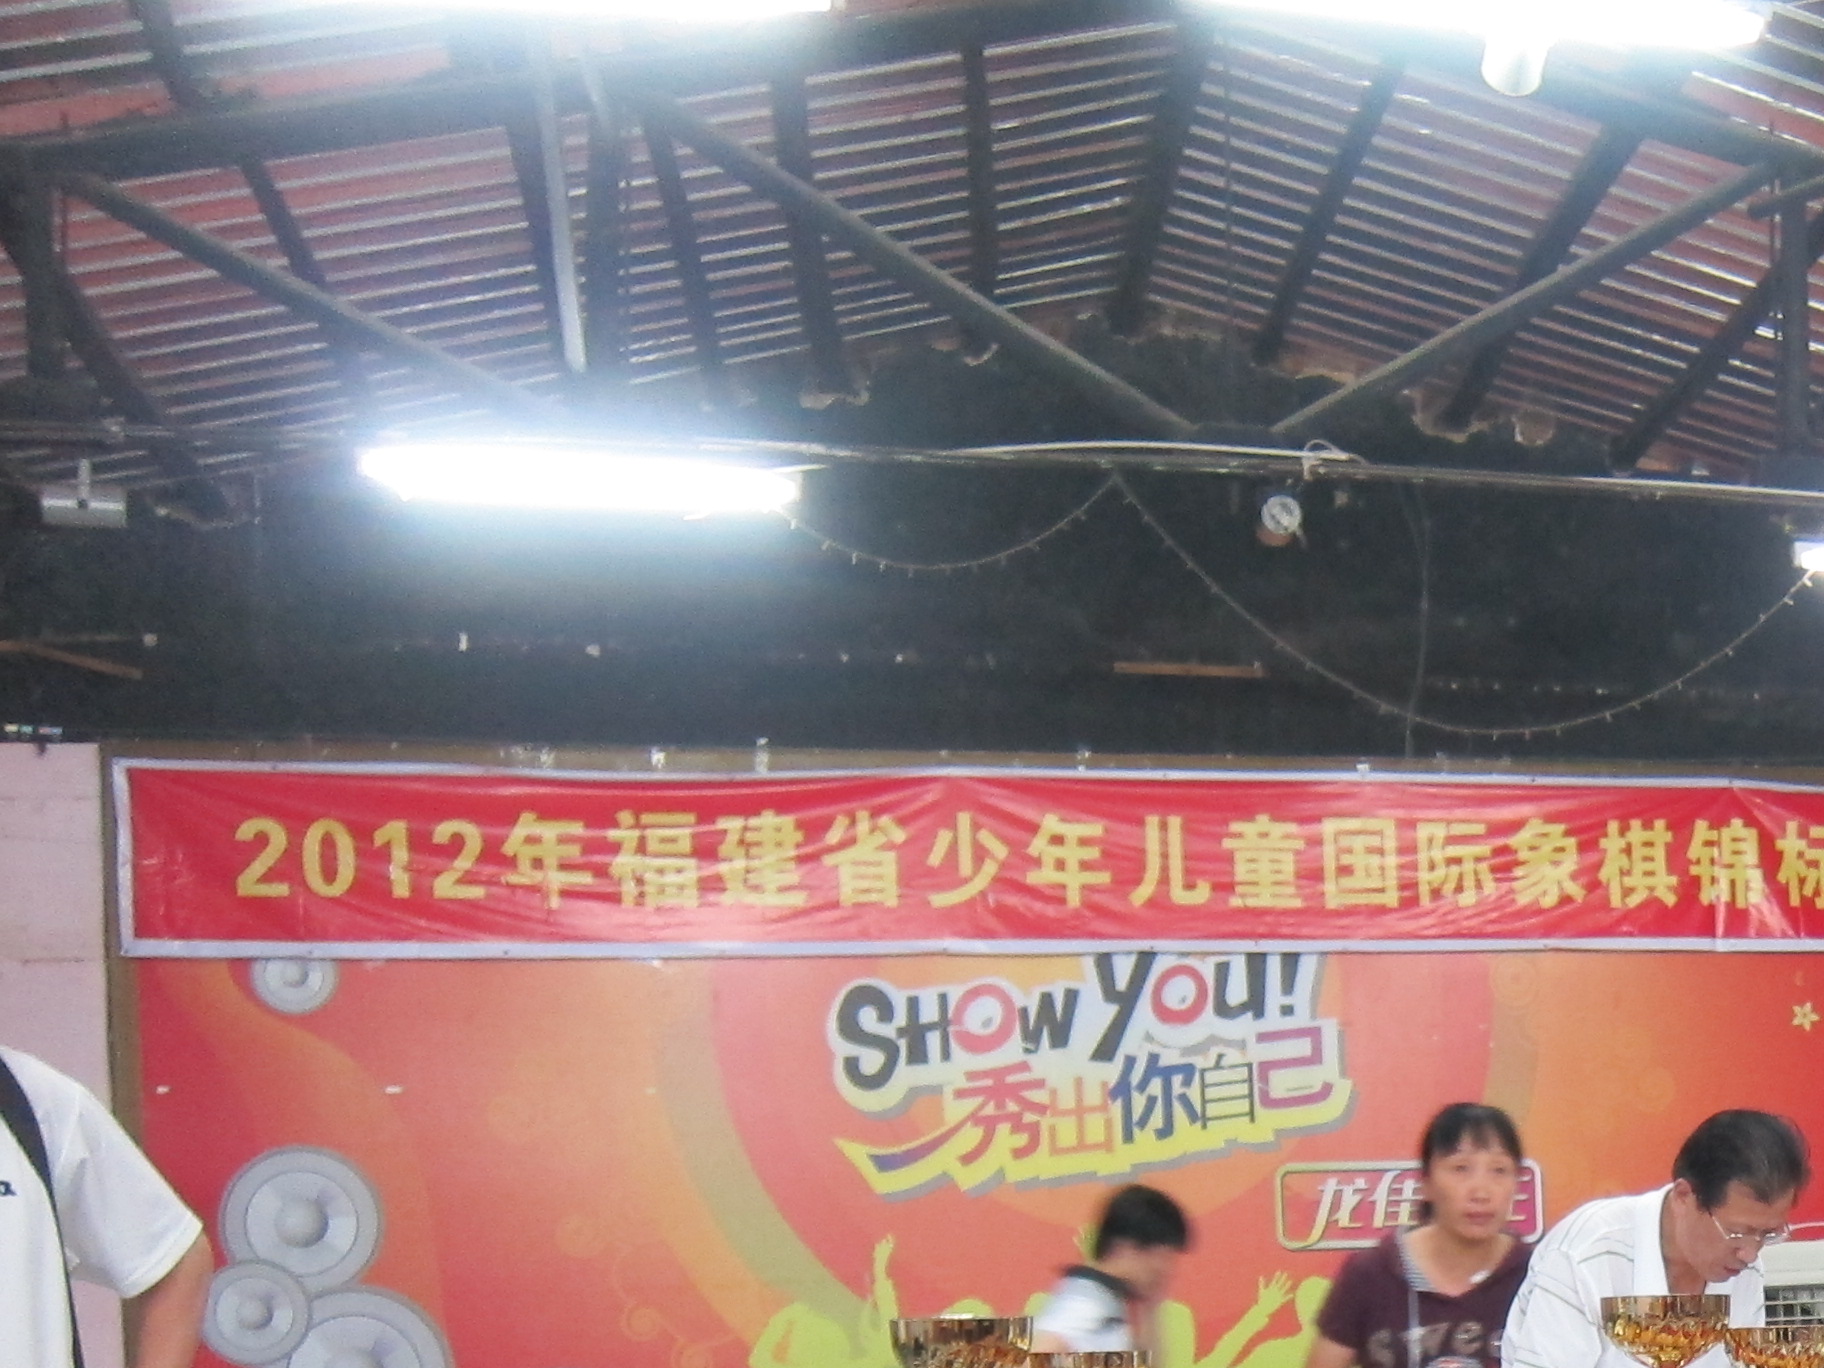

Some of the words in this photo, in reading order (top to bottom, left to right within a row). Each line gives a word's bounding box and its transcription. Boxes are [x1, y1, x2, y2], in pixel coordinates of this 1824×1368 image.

[870, 1026, 1333, 1167] 秀出你自己
